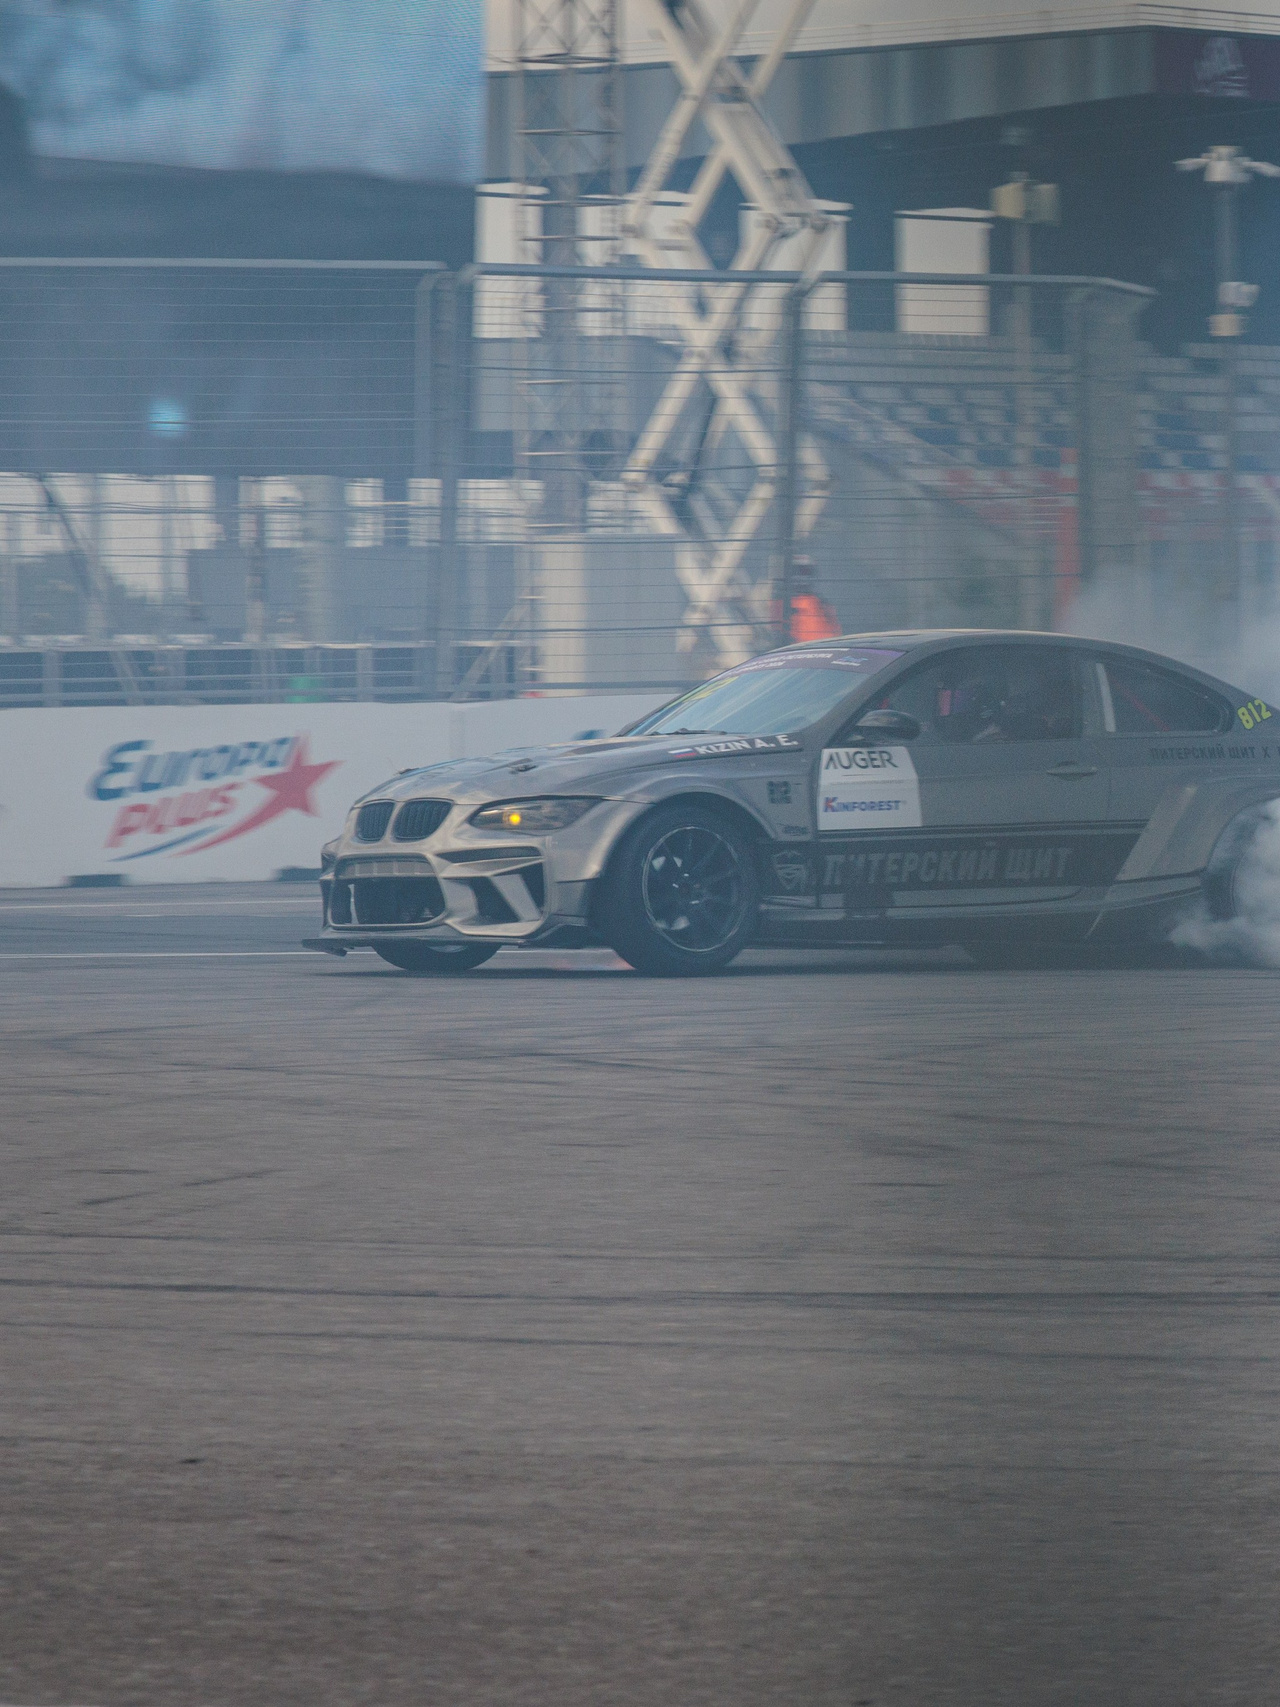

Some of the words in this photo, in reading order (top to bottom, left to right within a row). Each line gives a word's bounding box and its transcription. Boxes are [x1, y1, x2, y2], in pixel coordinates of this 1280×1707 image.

[1237, 698, 1272, 730] 812
[694, 739, 752, 755] KIZIN
[754, 738, 776, 749] A.
[776, 734, 799, 747] E.
[1150, 743, 1225, 761] ПИТЕРСКИЙ
[1229, 746, 1255, 760] ЩИТ
[88, 736, 298, 801] Europa
[825, 750, 899, 770] AUGER
[822, 797, 902, 813] KINFOREST
[1004, 847, 1074, 880] ЩИТ
